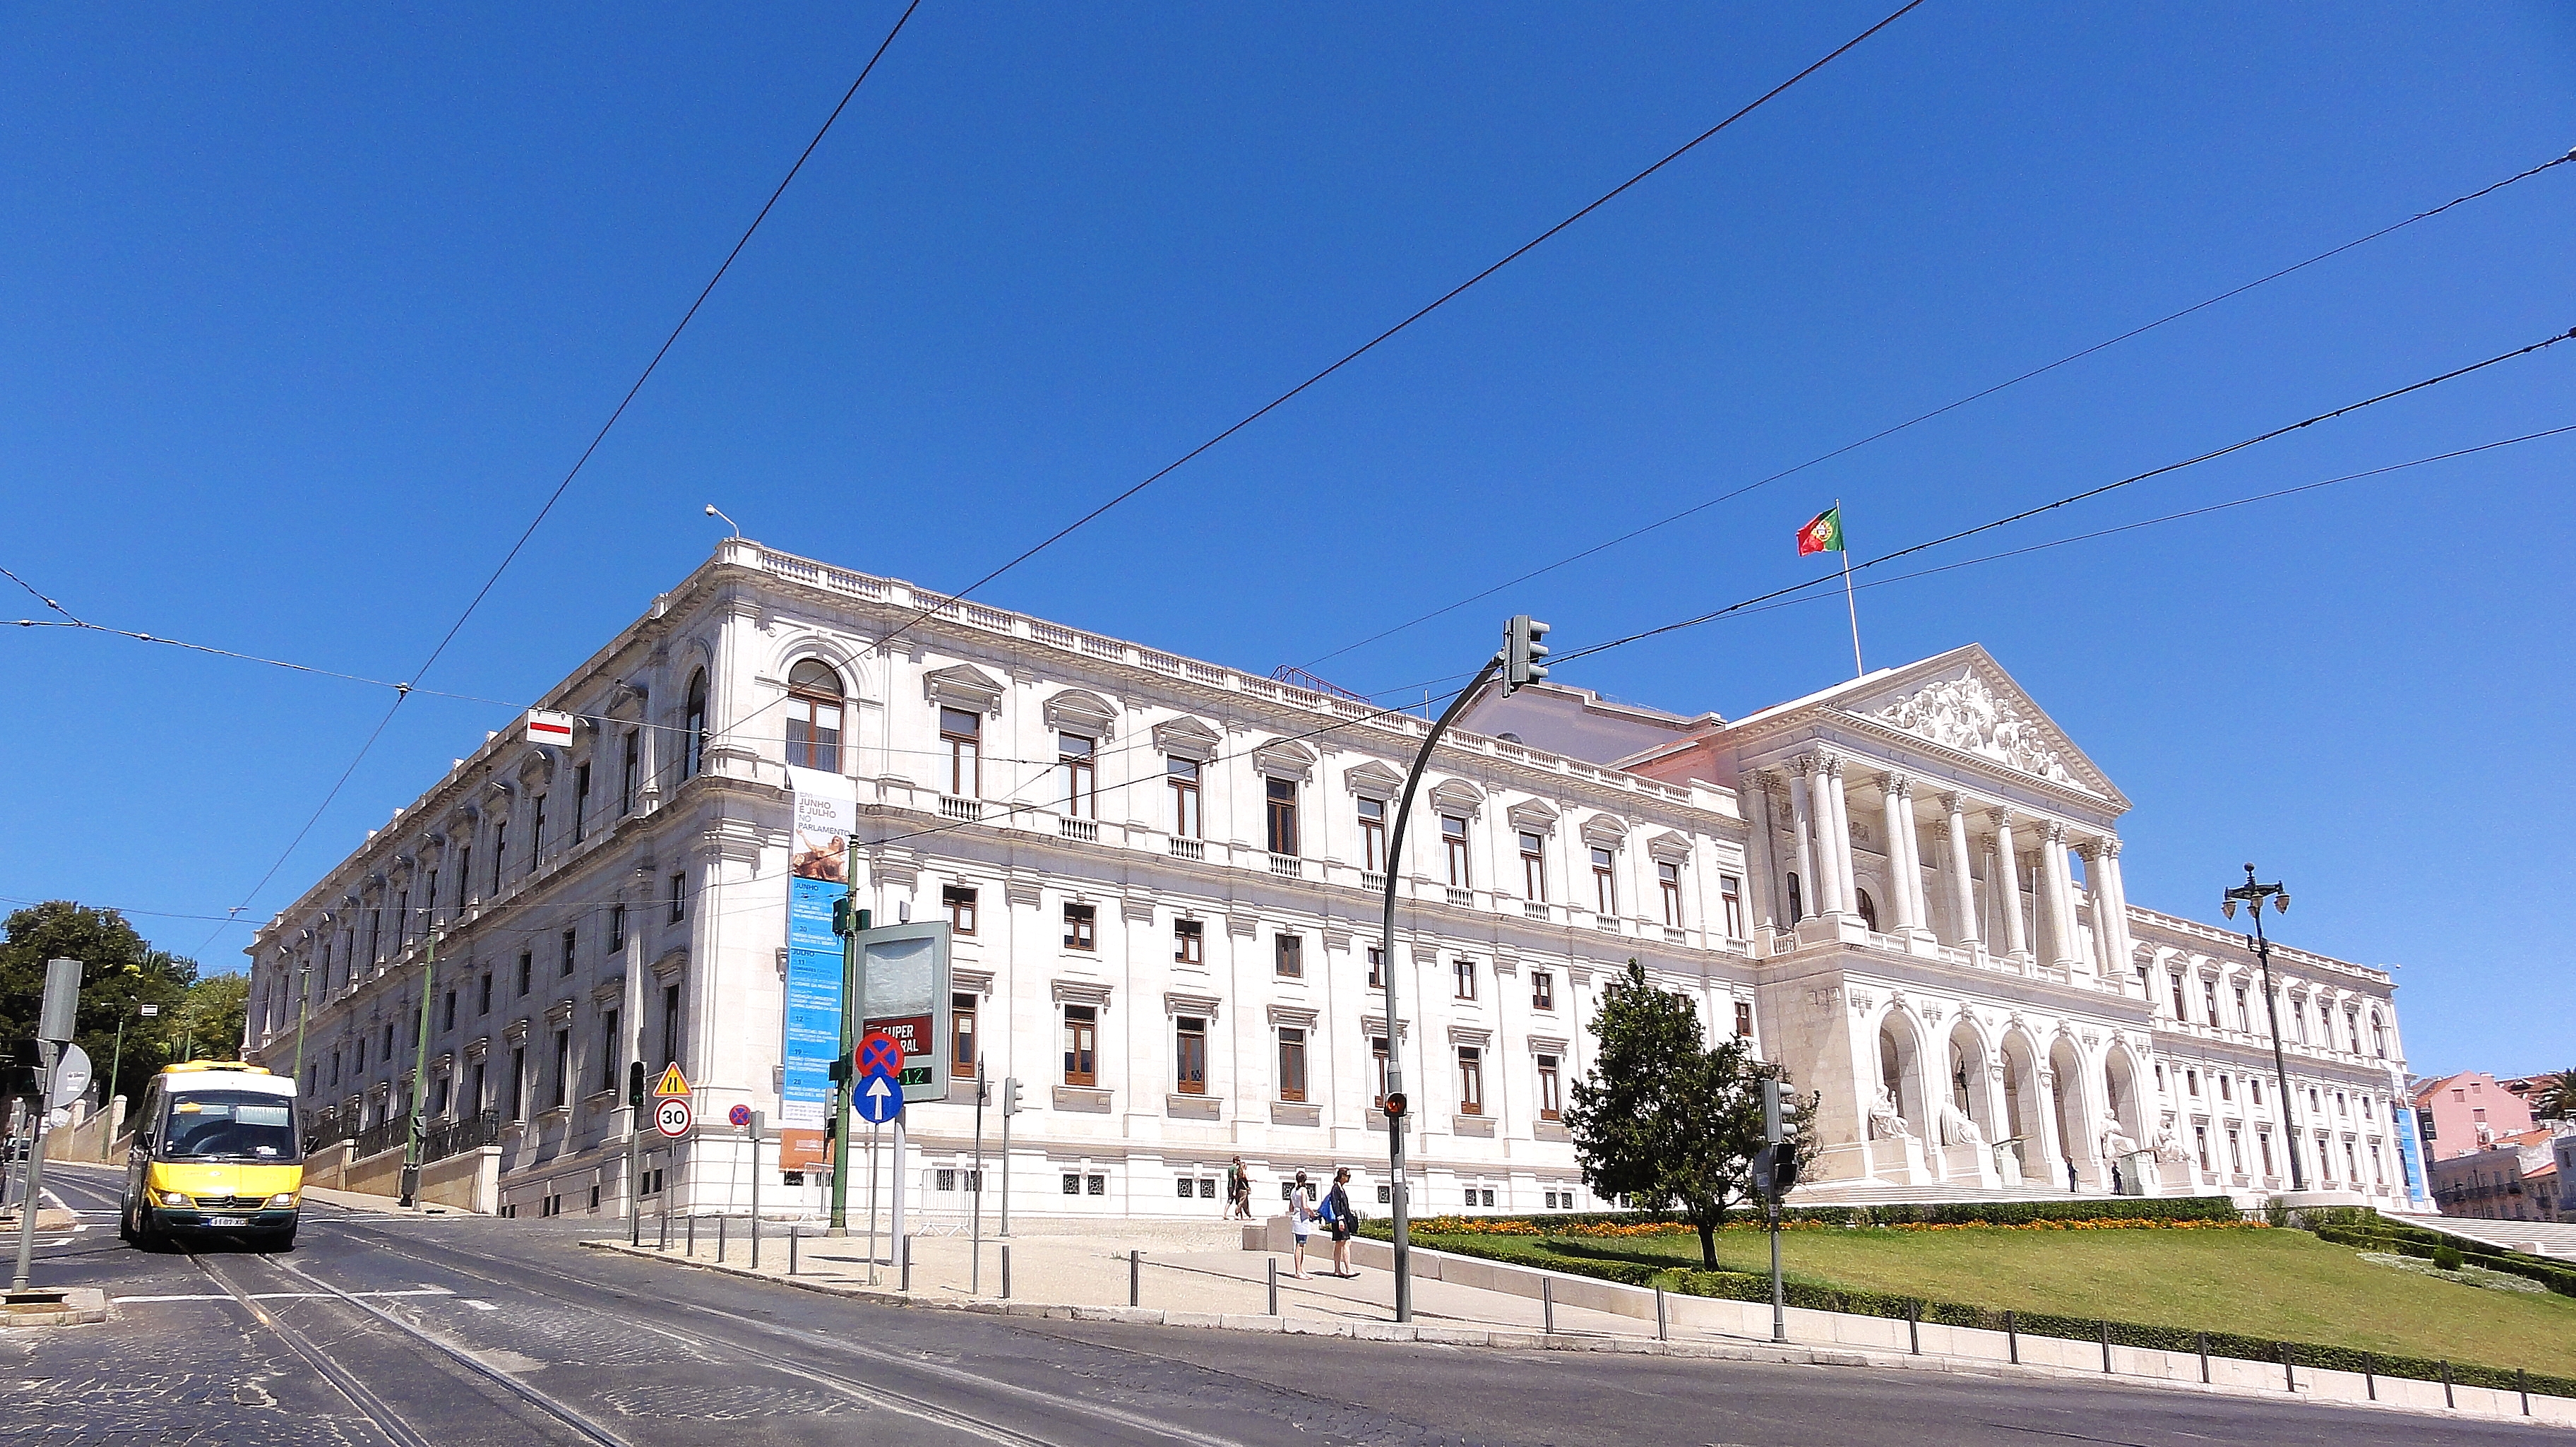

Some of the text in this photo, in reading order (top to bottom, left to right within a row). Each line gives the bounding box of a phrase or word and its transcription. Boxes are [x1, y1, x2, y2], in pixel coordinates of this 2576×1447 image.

[799, 798, 831, 809] JUNHO
[807, 807, 836, 818] JULHO
[799, 814, 811, 823] NO
[798, 822, 850, 837] PARLAMENTO
[794, 882, 819, 891] JUNHO
[900, 1039, 919, 1053] RAL
[662, 1110, 685, 1124] 30
